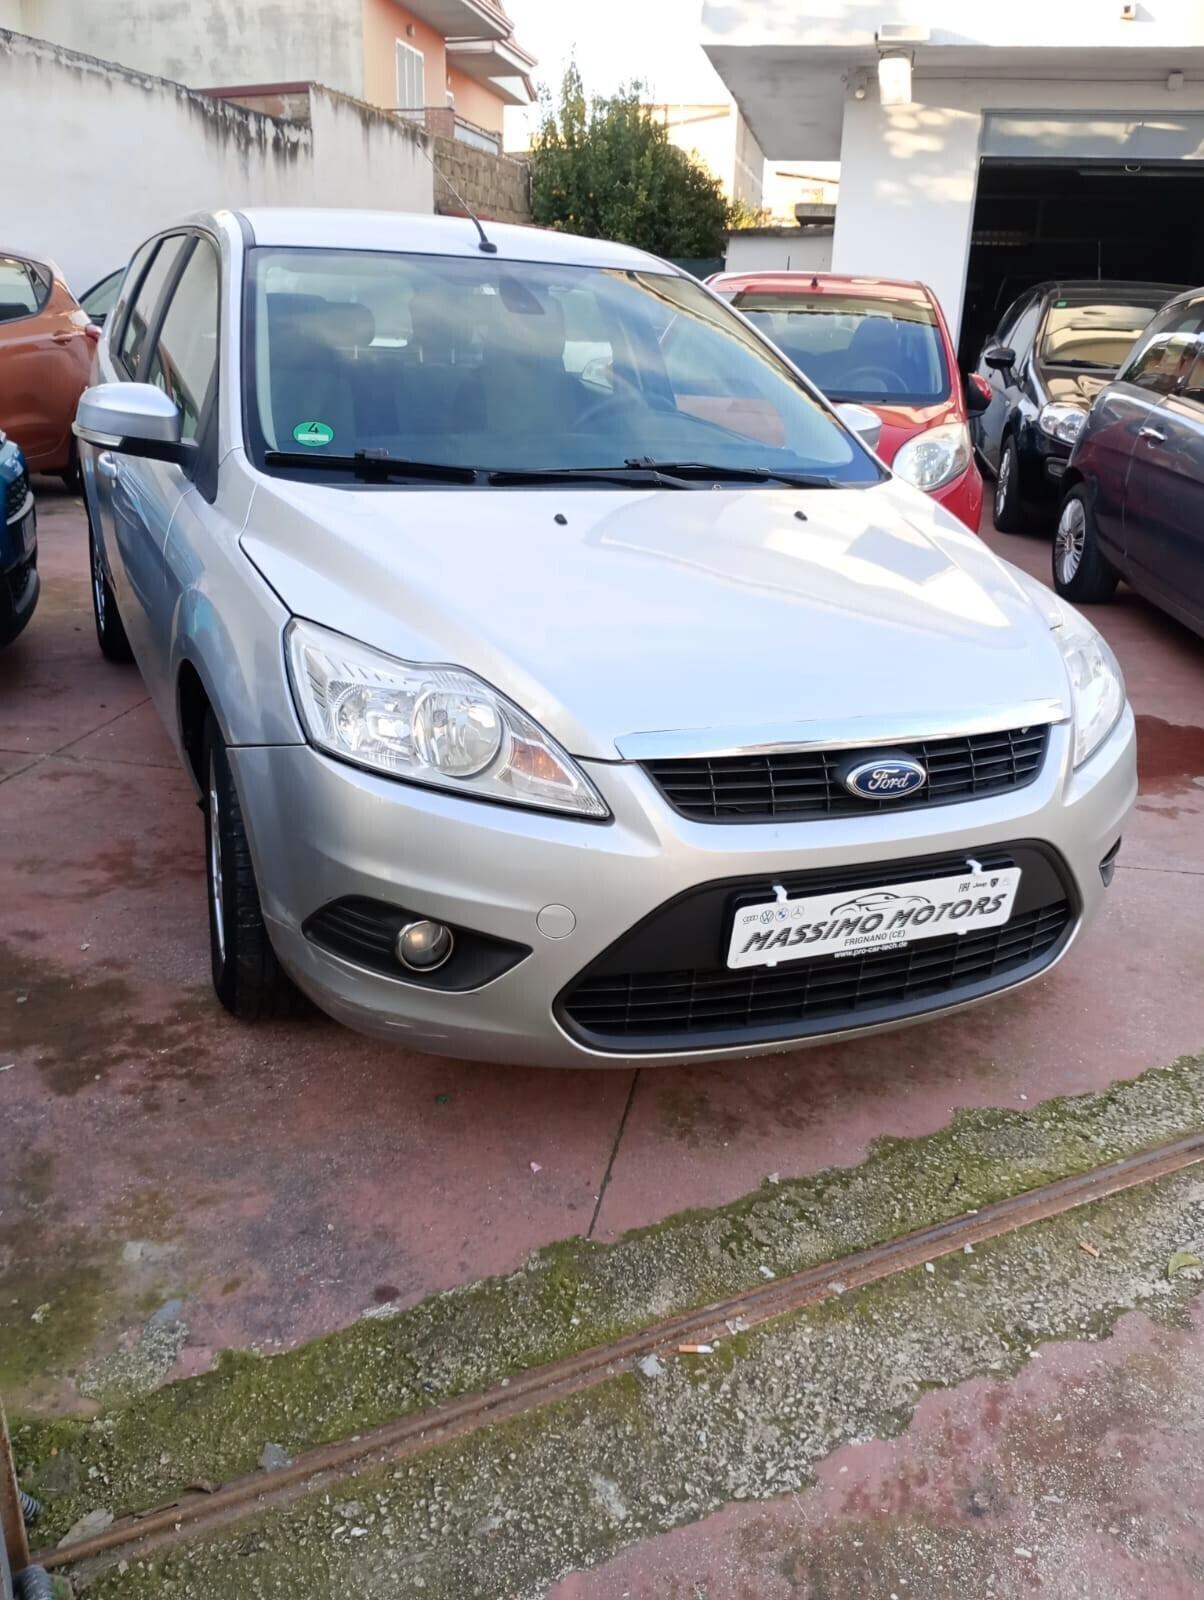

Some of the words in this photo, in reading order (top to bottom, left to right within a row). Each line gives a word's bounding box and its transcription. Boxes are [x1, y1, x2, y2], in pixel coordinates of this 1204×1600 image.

[307, 422, 320, 434] 4
[868, 768, 917, 790] Ford
[739, 913, 884, 953] MASSIMO
[885, 893, 1007, 930] MOTORS
[844, 933, 887, 946] FRIGNANO
[888, 929, 906, 941] (CE)
[834, 941, 908, 958] www.pro-car-tech.de
